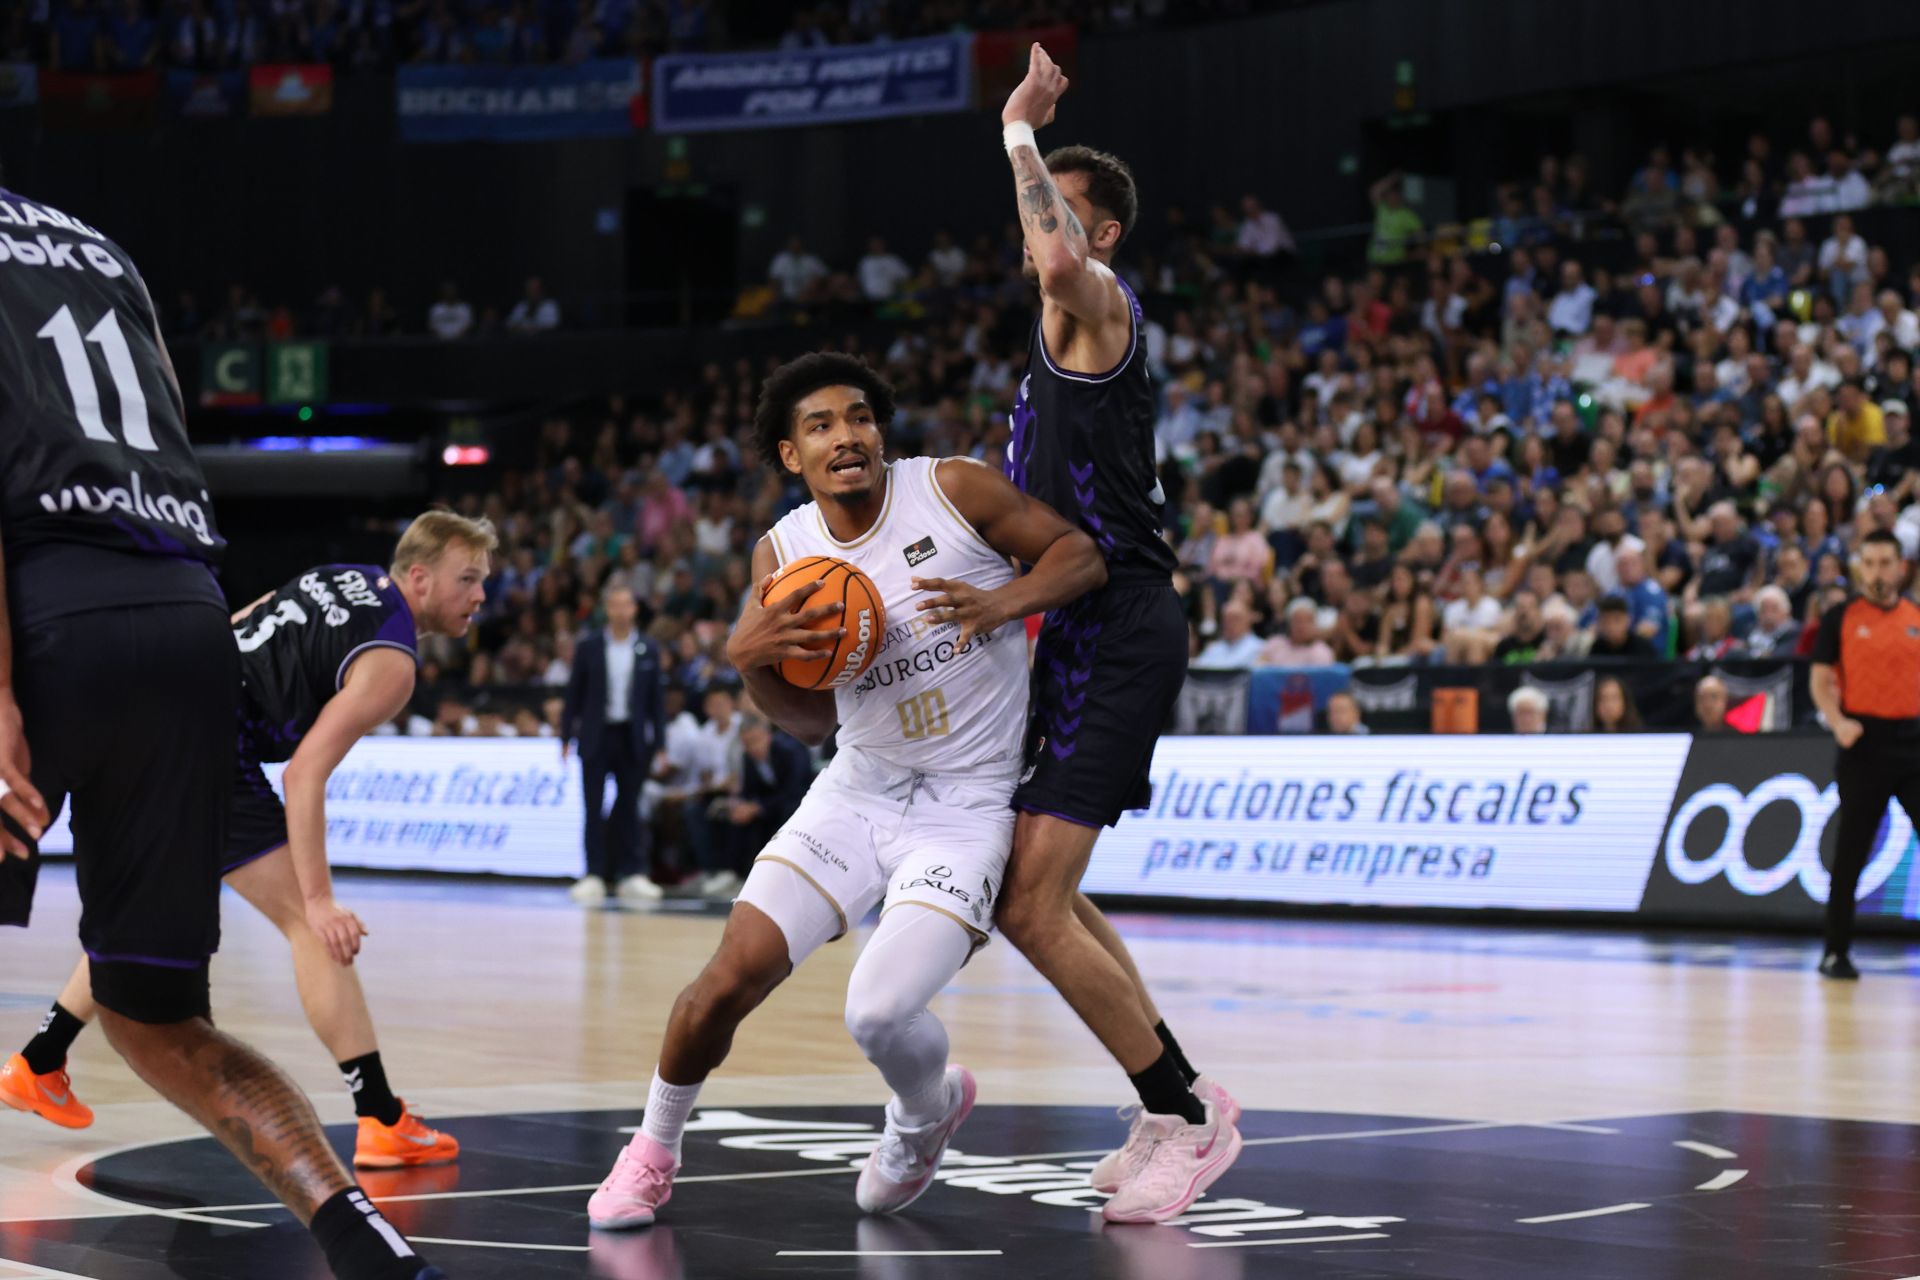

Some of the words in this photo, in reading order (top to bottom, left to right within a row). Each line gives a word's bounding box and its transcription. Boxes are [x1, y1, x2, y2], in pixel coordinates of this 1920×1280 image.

[36, 303, 160, 451] 11
[39, 470, 215, 546] vueling
[333, 570, 382, 607] FREY
[827, 608, 871, 687] Wilson
[896, 688, 950, 740] 00
[326, 767, 439, 805] uciones
[1130, 768, 1364, 822] luciones
[1378, 770, 1590, 825] fiscales
[396, 819, 511, 854] empresa
[1139, 838, 1239, 879] para
[1248, 842, 1295, 872] su
[1303, 839, 1497, 888] empresa
[900, 878, 970, 903] LEXUS
